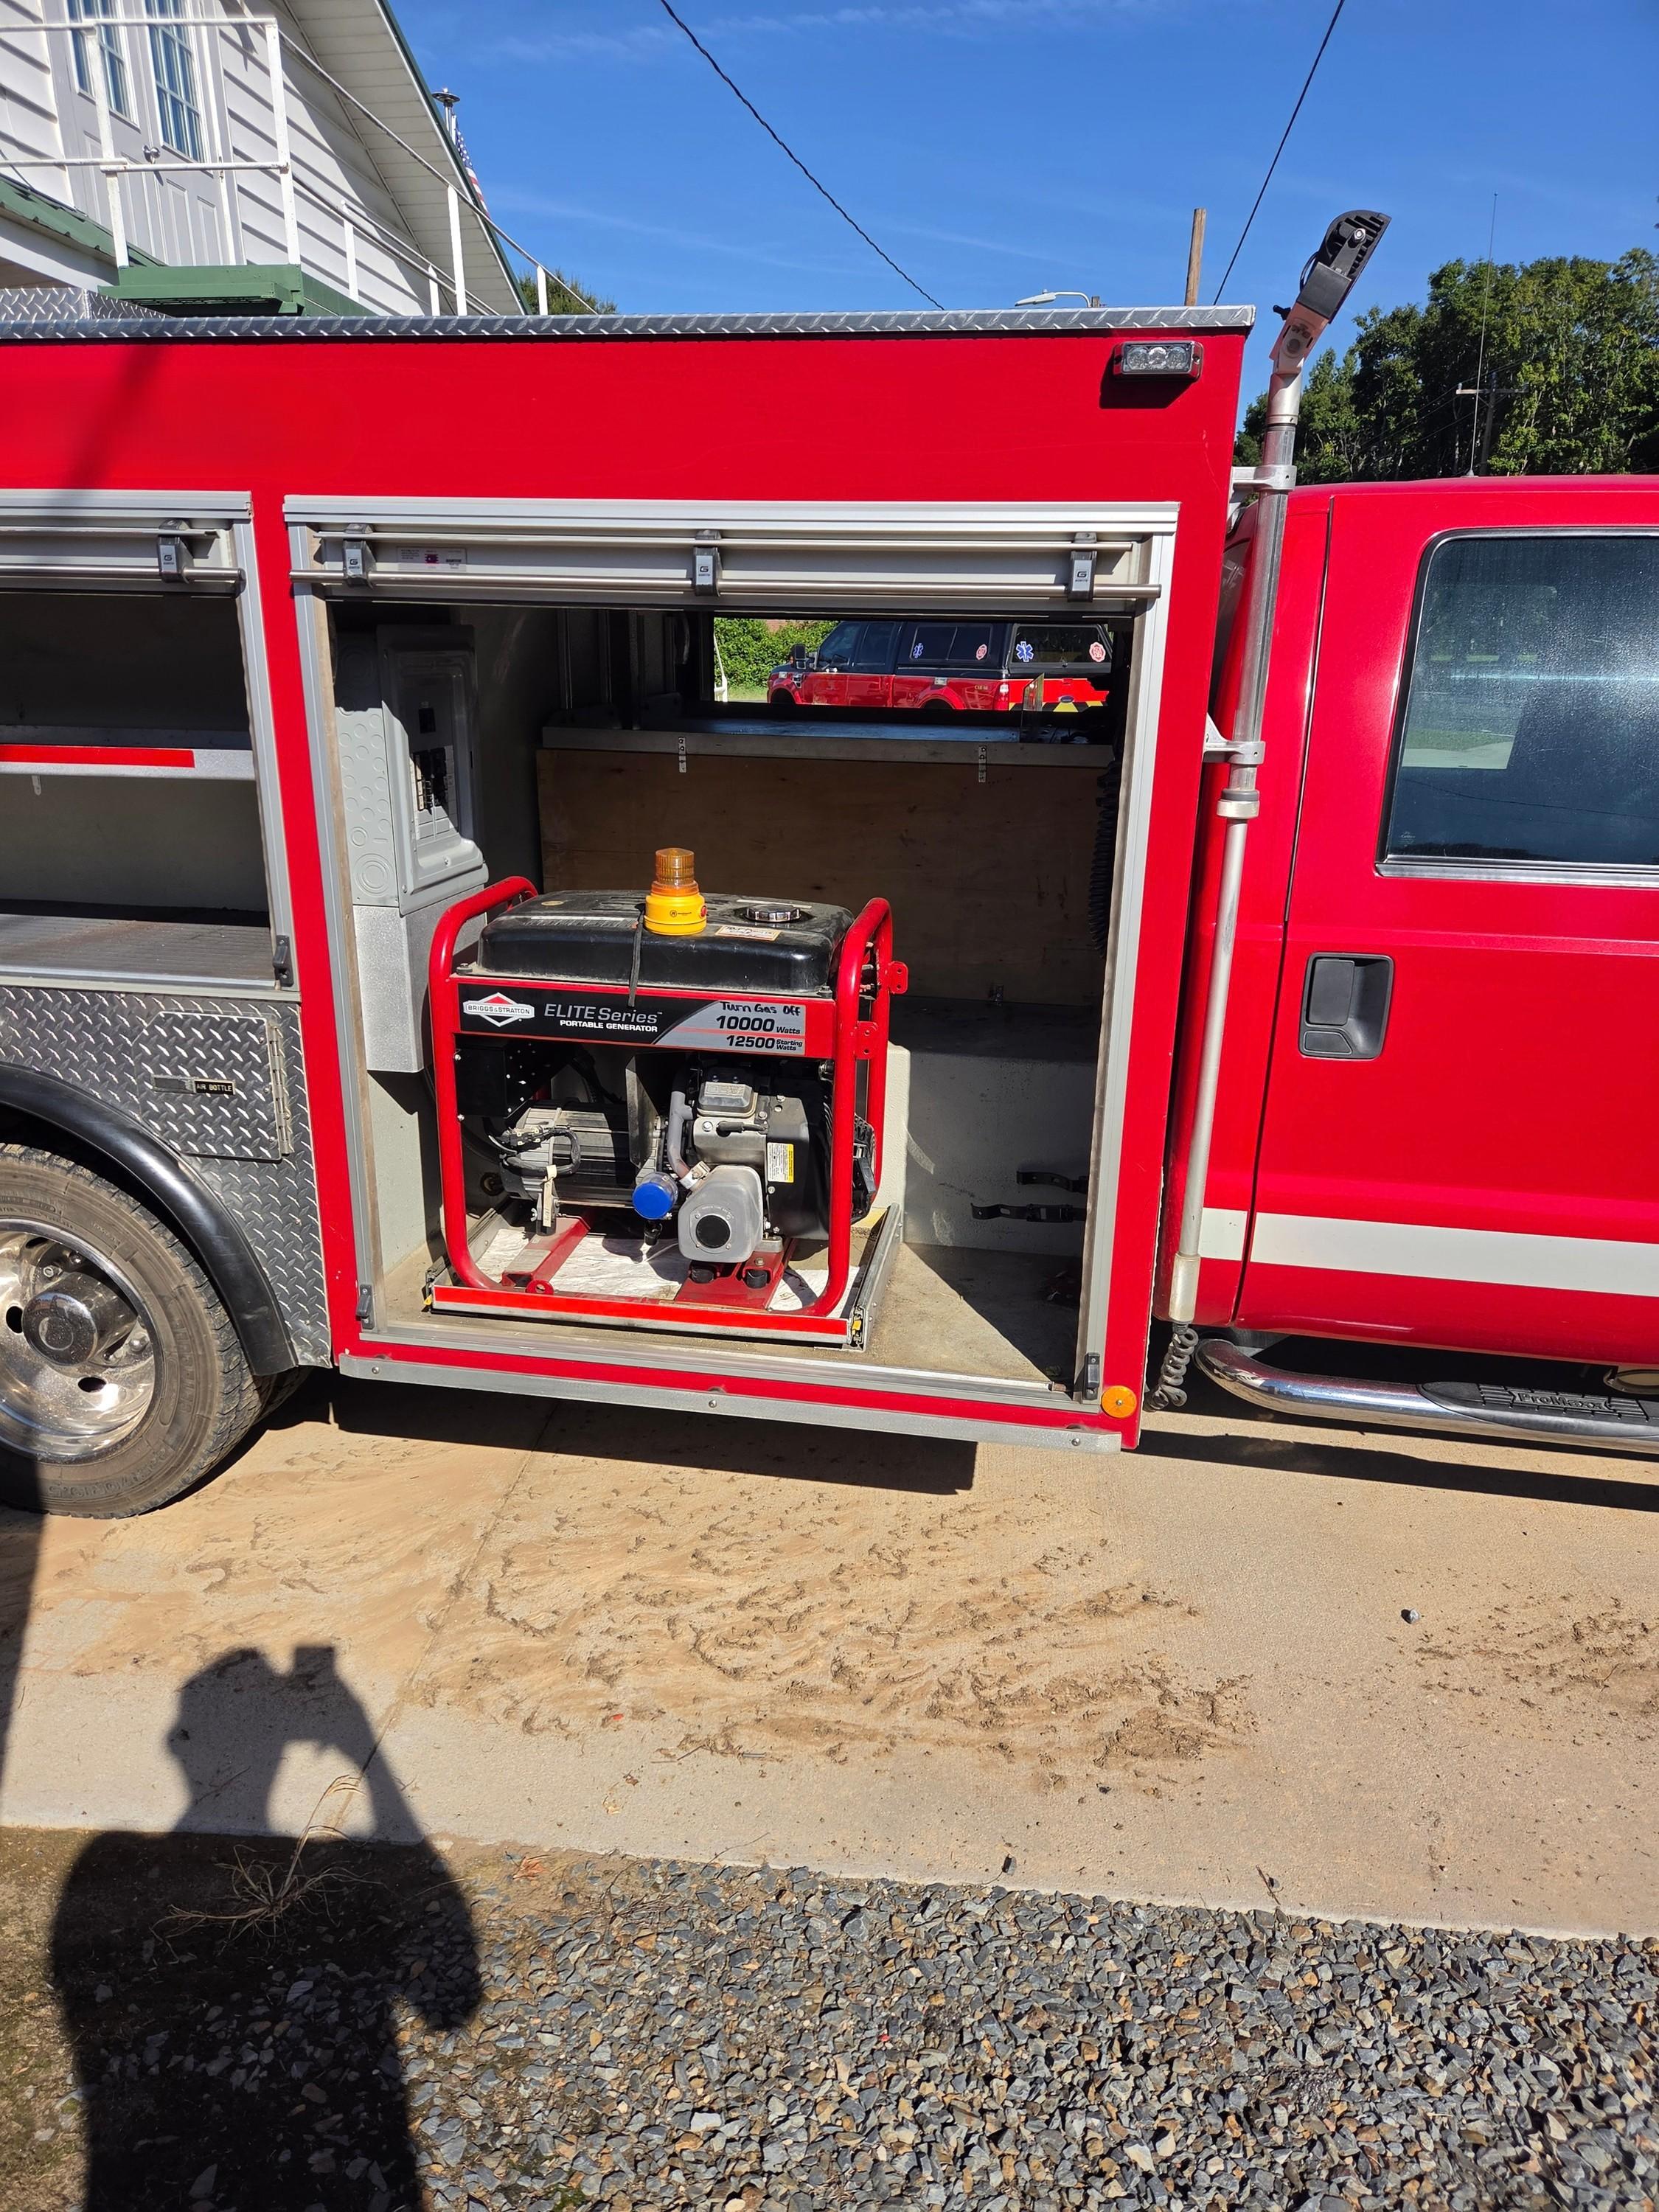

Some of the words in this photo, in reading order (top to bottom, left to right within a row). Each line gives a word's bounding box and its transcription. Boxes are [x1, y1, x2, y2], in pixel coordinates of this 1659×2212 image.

[543, 1004, 595, 1019] ELITE
[720, 1001, 751, 1012] Turn
[754, 1004, 777, 1014] Gas
[560, 1020, 604, 1029] PORTABLE
[606, 1023, 658, 1032] GENERATOR
[716, 1015, 775, 1032] 10000
[776, 1026, 801, 1034] Watts
[726, 1035, 775, 1049] 12500
[776, 1039, 803, 1047] Starting
